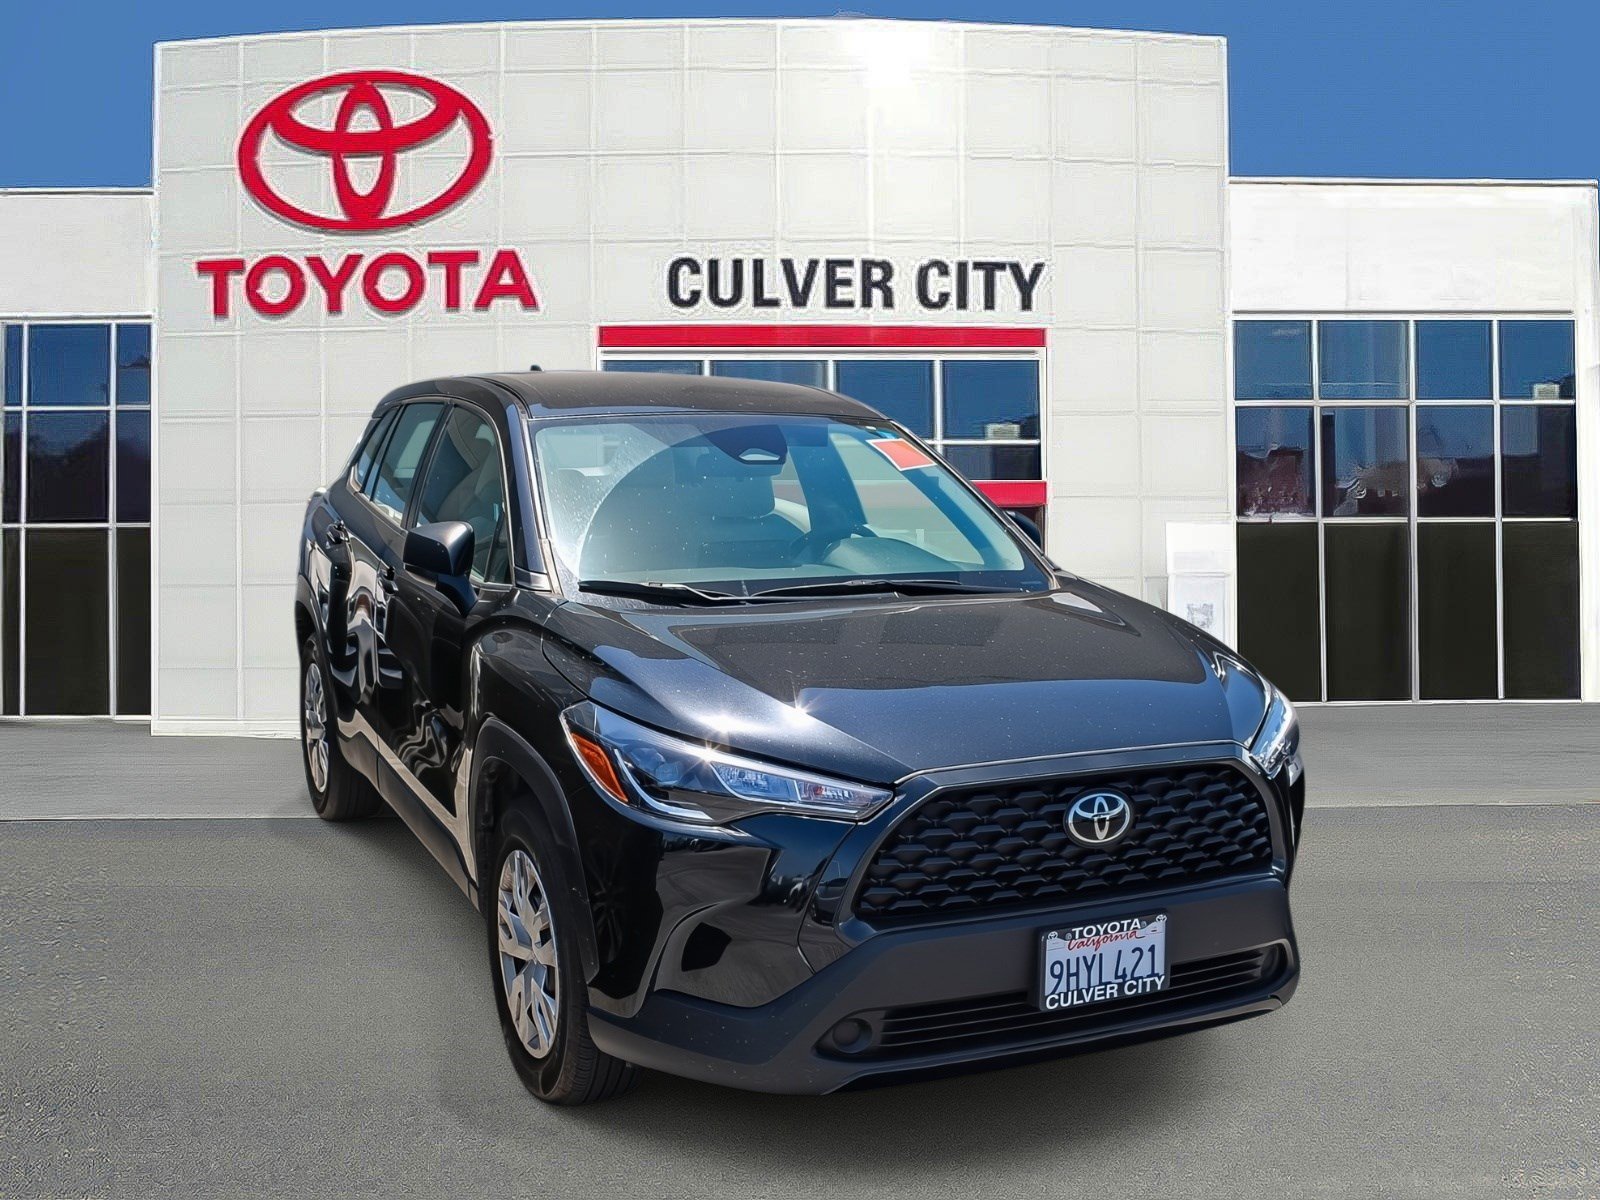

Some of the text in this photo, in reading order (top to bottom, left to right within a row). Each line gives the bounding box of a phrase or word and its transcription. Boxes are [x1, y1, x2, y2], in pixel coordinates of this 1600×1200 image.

[195, 249, 540, 319] TOYOTA
[667, 257, 1046, 310] CULVER CITY
[1067, 930, 1145, 952] California
[1072, 918, 1141, 940] TOYOTA
[1050, 944, 1160, 995] 9HYL421
[1046, 975, 1165, 1010] CULVER CITY
